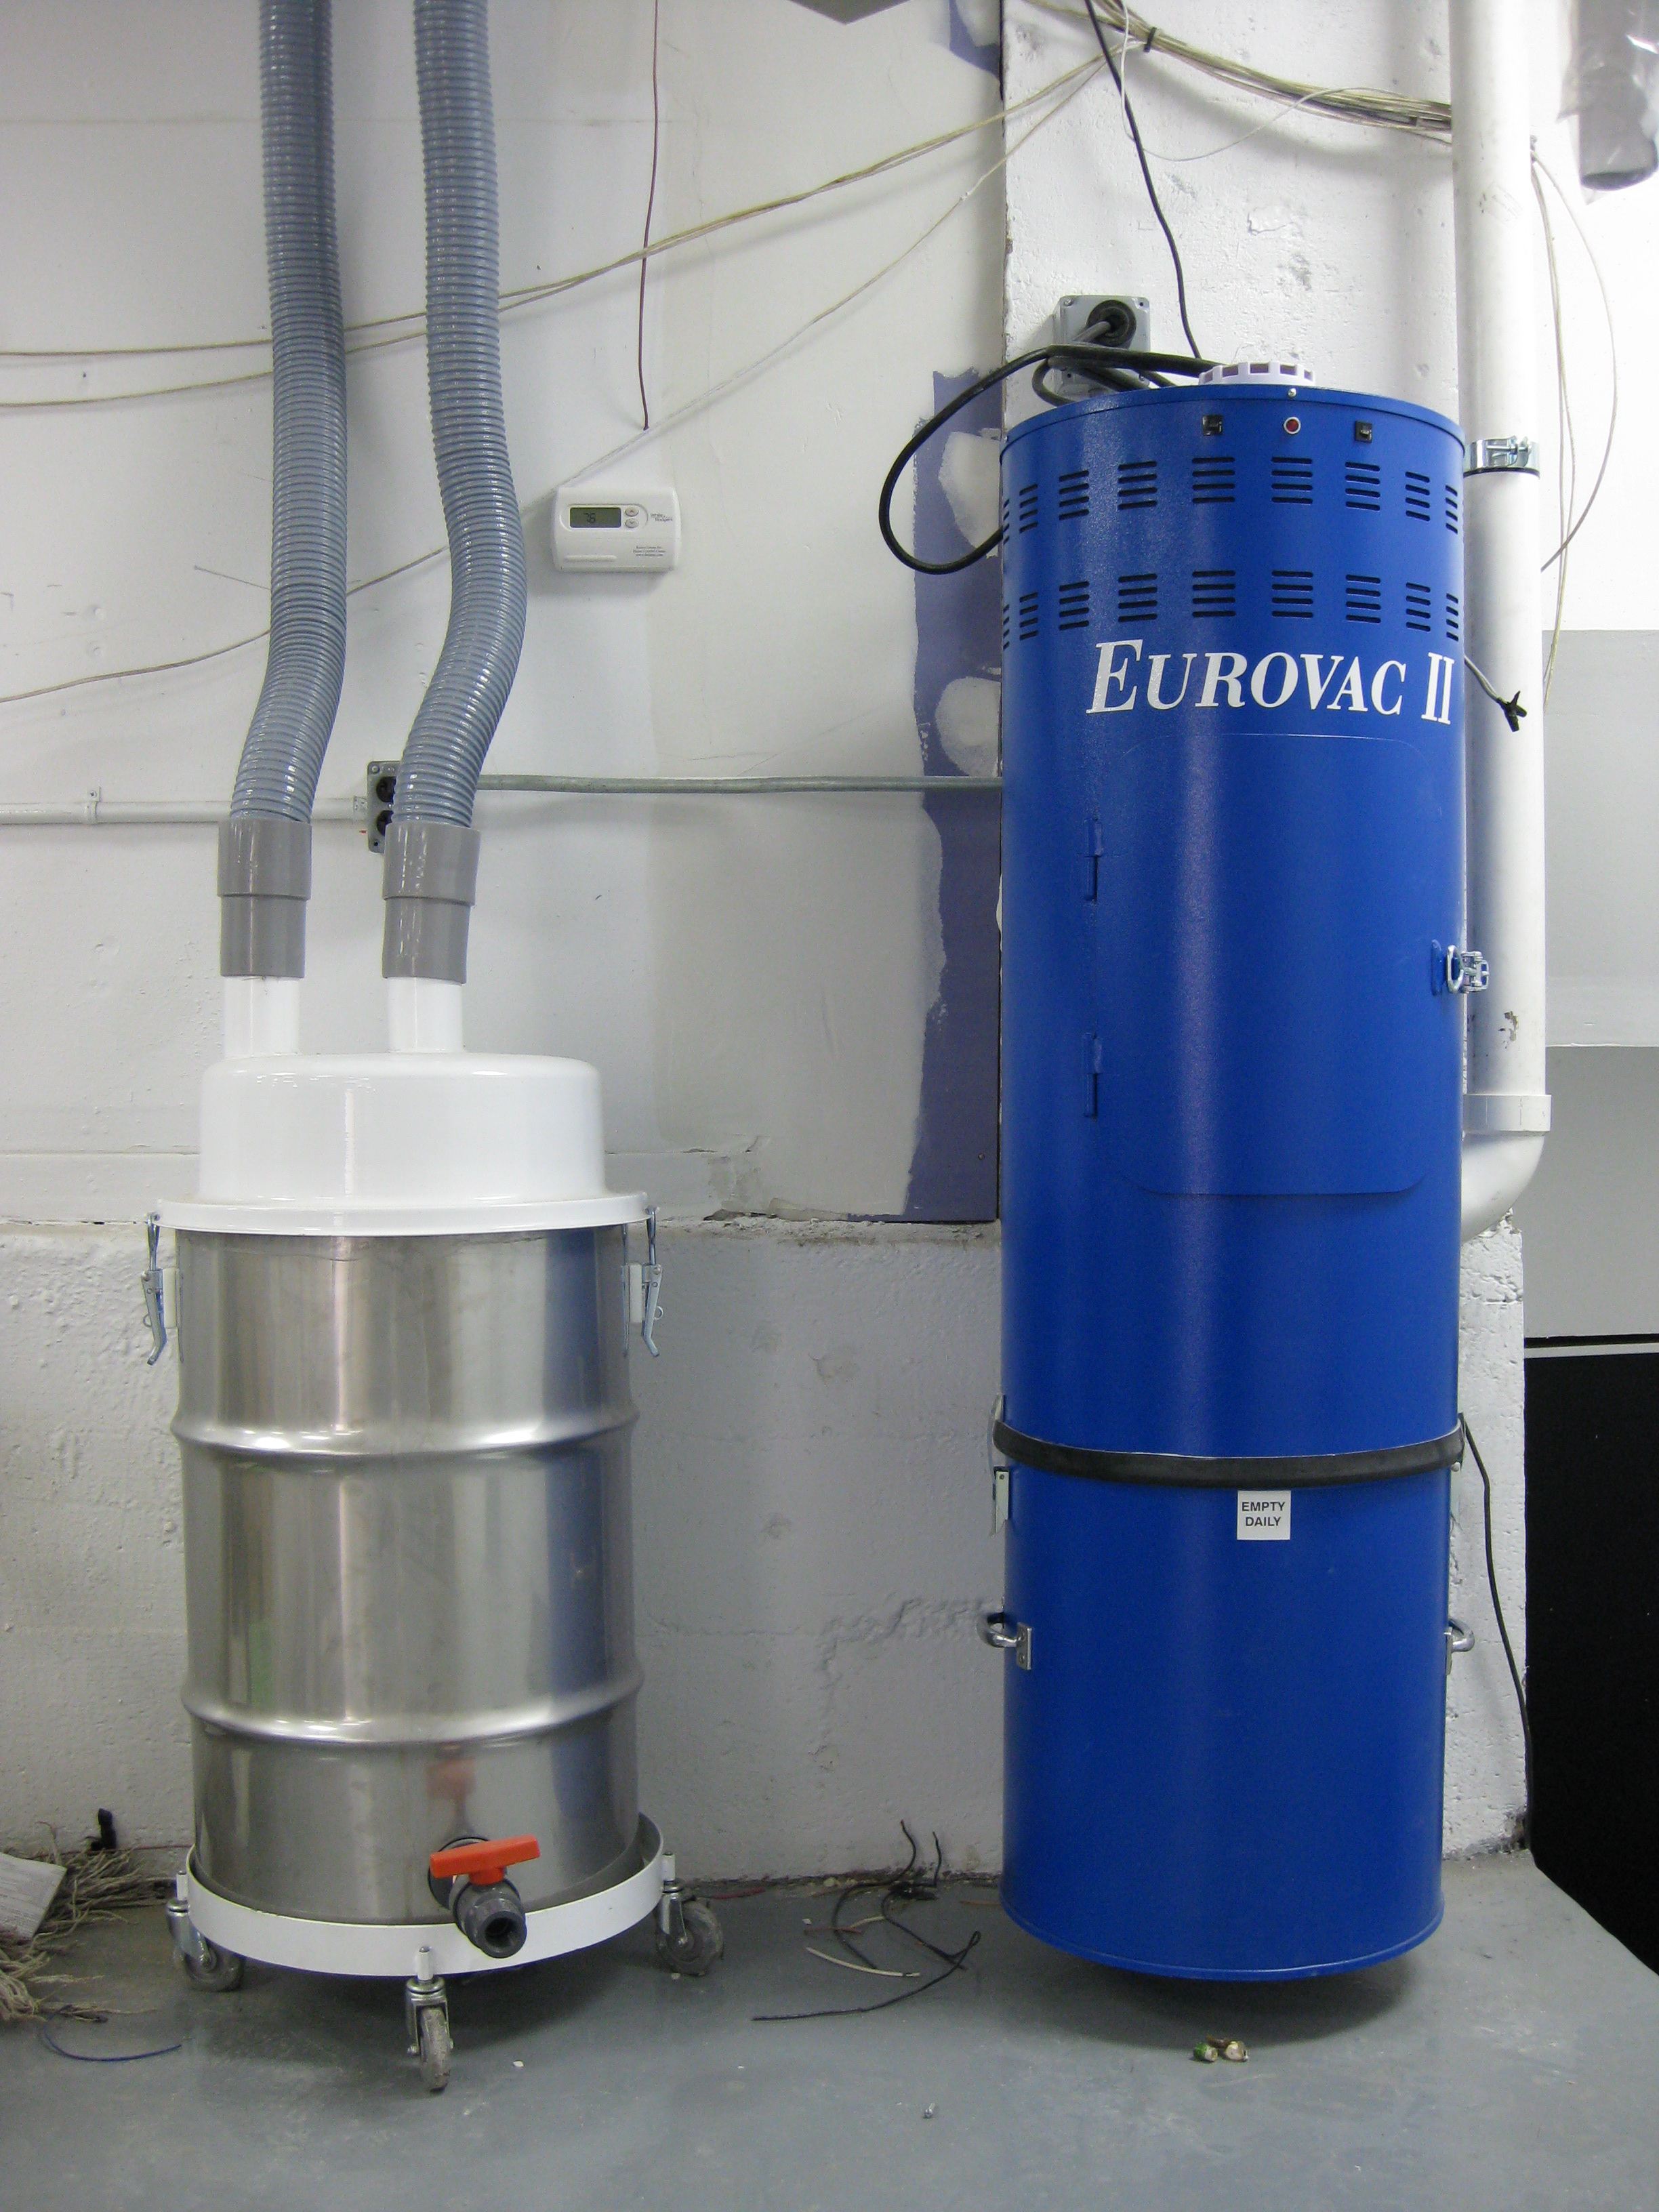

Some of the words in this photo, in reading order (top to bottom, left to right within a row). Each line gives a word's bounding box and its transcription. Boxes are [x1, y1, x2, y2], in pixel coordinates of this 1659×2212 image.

[1086, 638, 1406, 716] EUROVAC
[1421, 651, 1454, 724] II
[1242, 1501, 1286, 1512] EMPTY
[1245, 1516, 1282, 1527] DAILY
